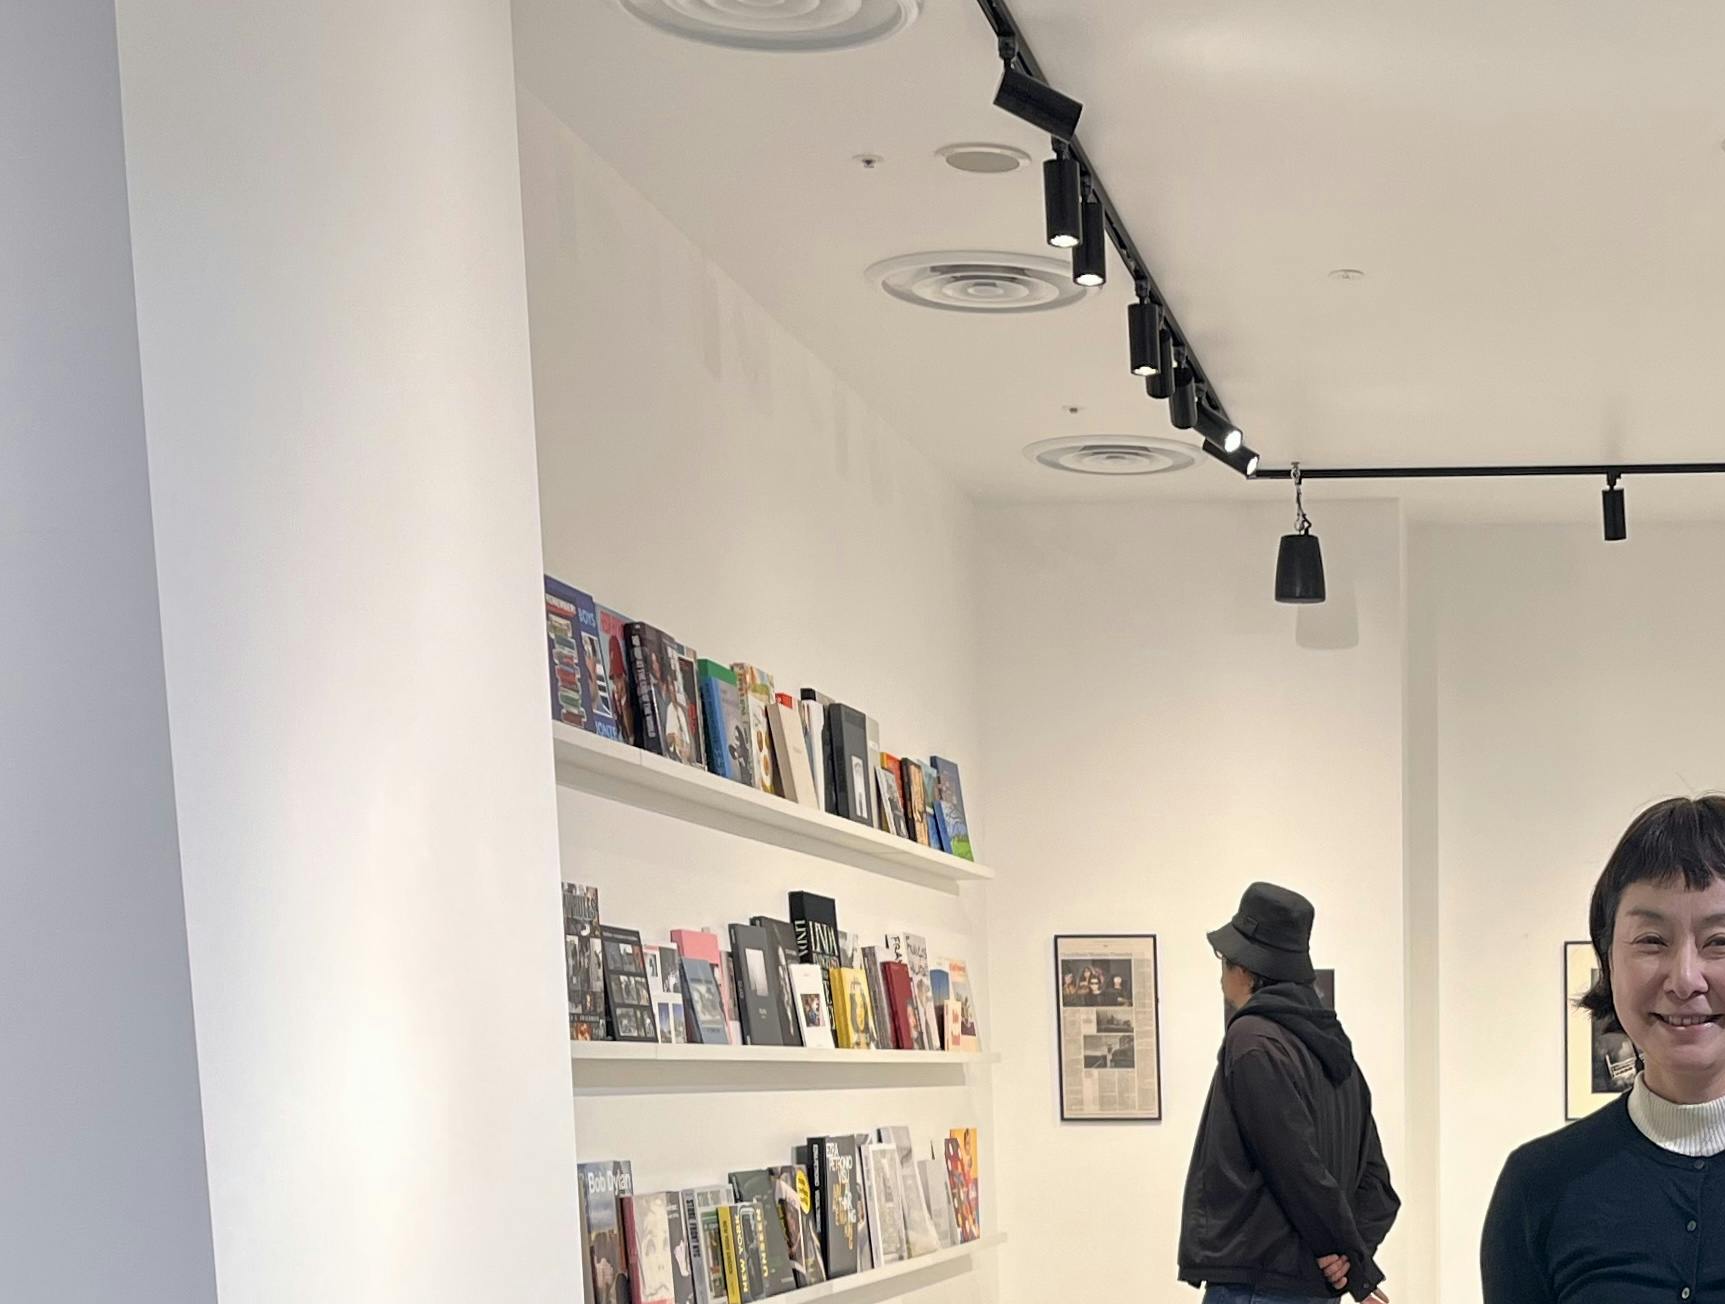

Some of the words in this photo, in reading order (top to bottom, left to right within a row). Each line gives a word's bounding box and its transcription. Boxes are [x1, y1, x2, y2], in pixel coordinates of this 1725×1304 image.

[588, 1172, 606, 1192] Bob
[607, 1170, 631, 1196] Dylan
[735, 1214, 743, 1255] YORK
[740, 1259, 750, 1293] NEW
